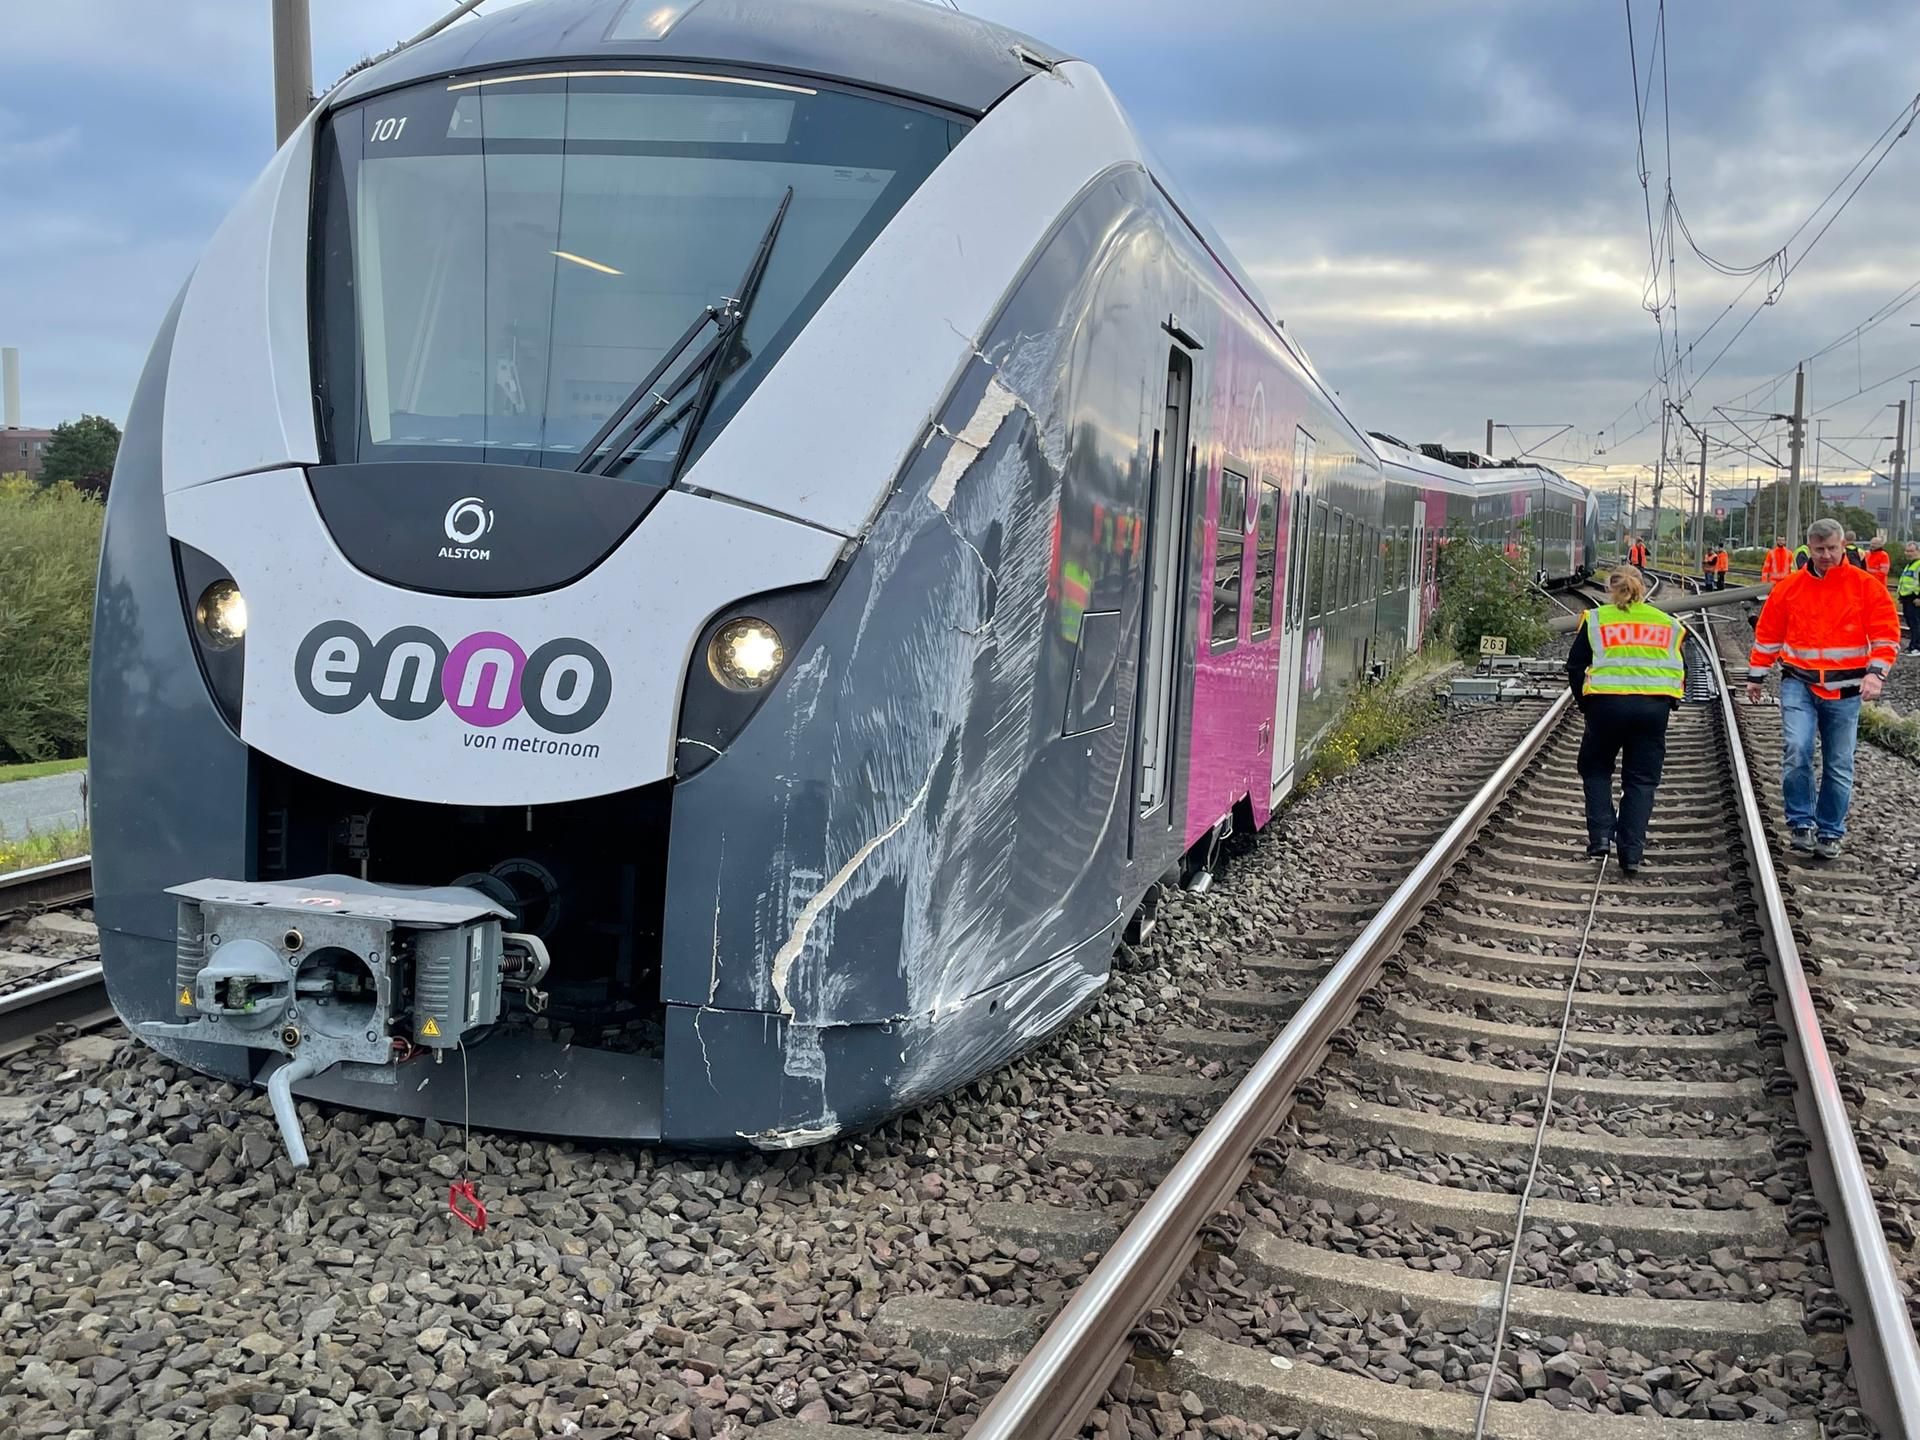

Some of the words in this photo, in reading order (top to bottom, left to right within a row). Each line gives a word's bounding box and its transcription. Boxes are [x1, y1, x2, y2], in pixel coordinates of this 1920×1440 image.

[370, 117, 408, 142] 101
[438, 547, 490, 560] ALSTOM
[1482, 639, 1504, 651] 263
[1605, 624, 1669, 647] POLIZEI
[307, 633, 598, 718] enno
[463, 733, 497, 749] von
[502, 736, 600, 759] metronom
